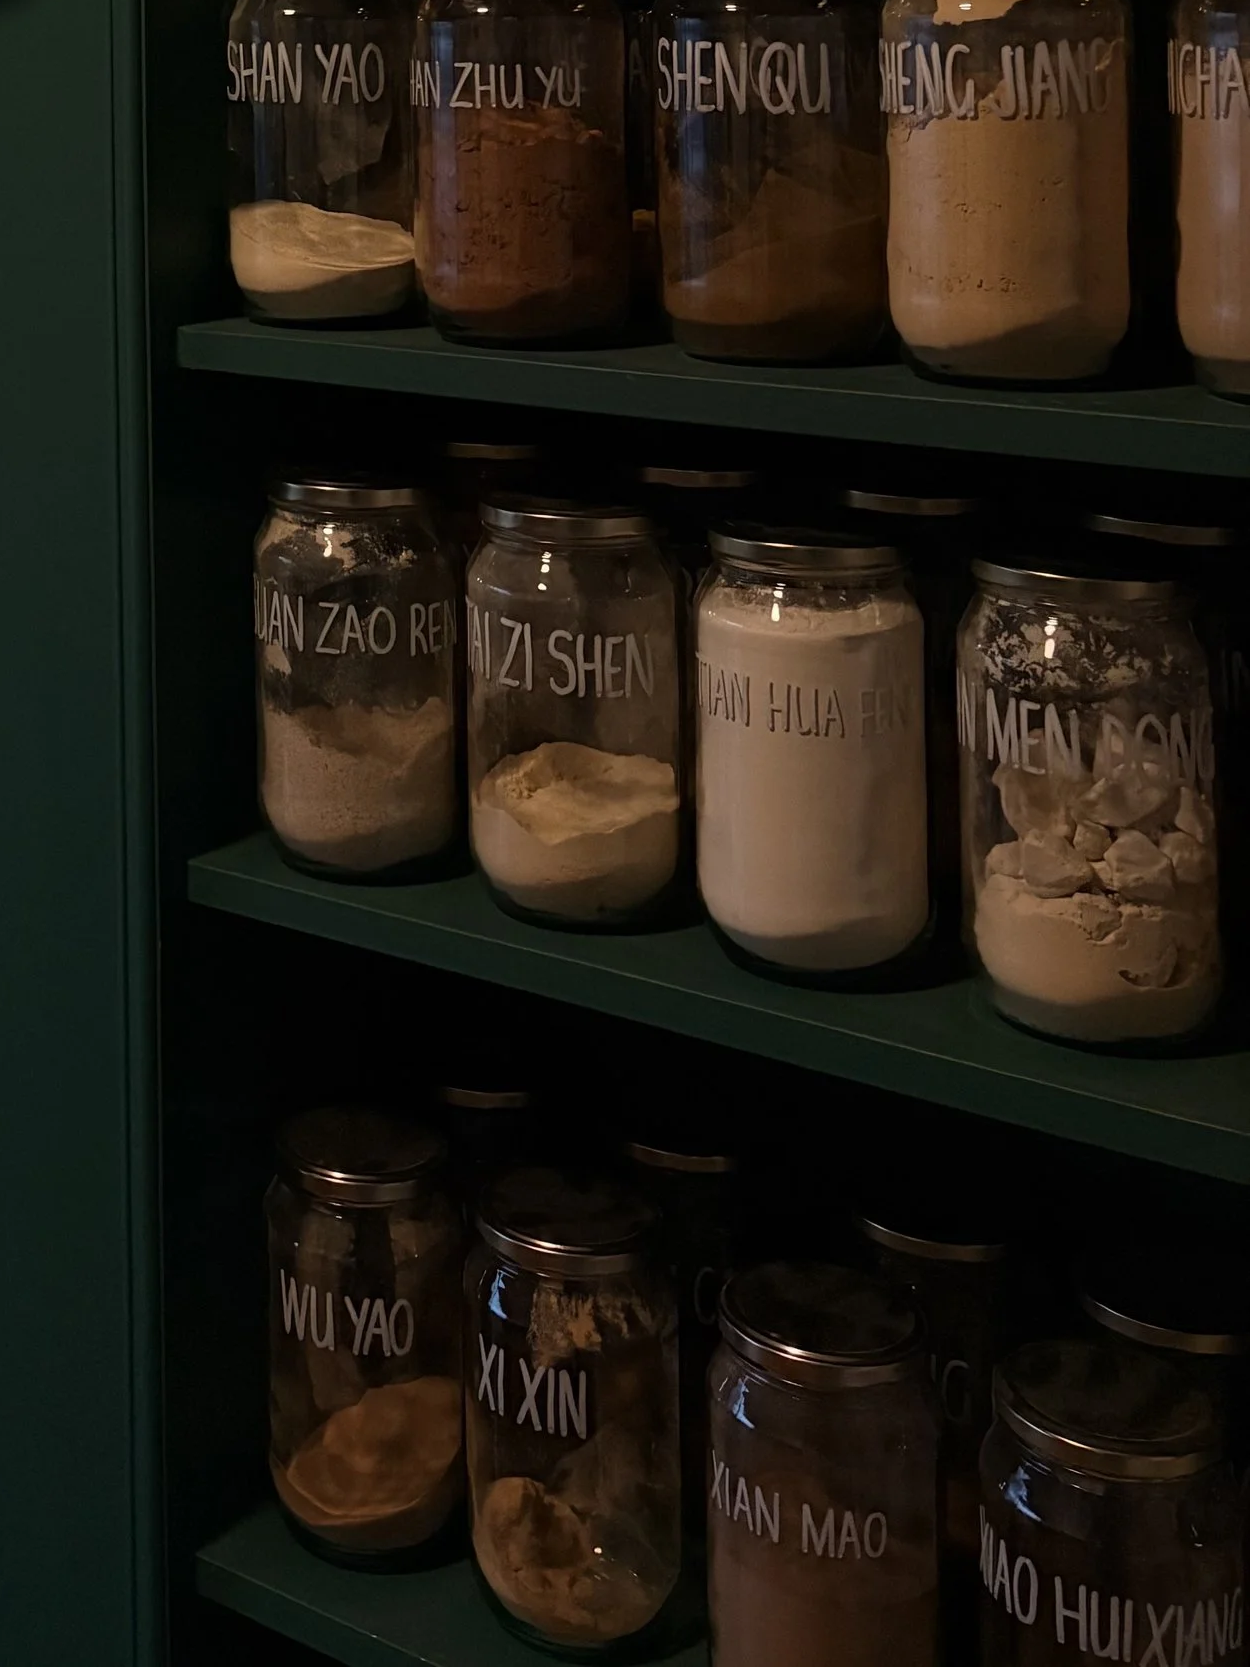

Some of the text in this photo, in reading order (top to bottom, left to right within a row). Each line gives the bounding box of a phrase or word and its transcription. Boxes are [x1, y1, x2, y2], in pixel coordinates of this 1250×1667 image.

[226, 40, 385, 105] SHAN YAO
[449, 61, 526, 109] ZHU
[533, 64, 582, 108] YU
[657, 37, 832, 116] SHEN QU
[996, 38, 1117, 121] JIANG
[315, 601, 397, 655] ZAO
[499, 616, 533, 691] ZI
[549, 628, 652, 698] SHEN
[695, 651, 751, 728] TIAN
[767, 681, 846, 738] HUA
[985, 688, 1216, 784] MEN DONG
[279, 1268, 415, 1357] WU YAO
[478, 1333, 587, 1440] XI XIN
[712, 1449, 889, 1561] XIAN MAO
[1053, 1574, 1134, 1664] HUI
